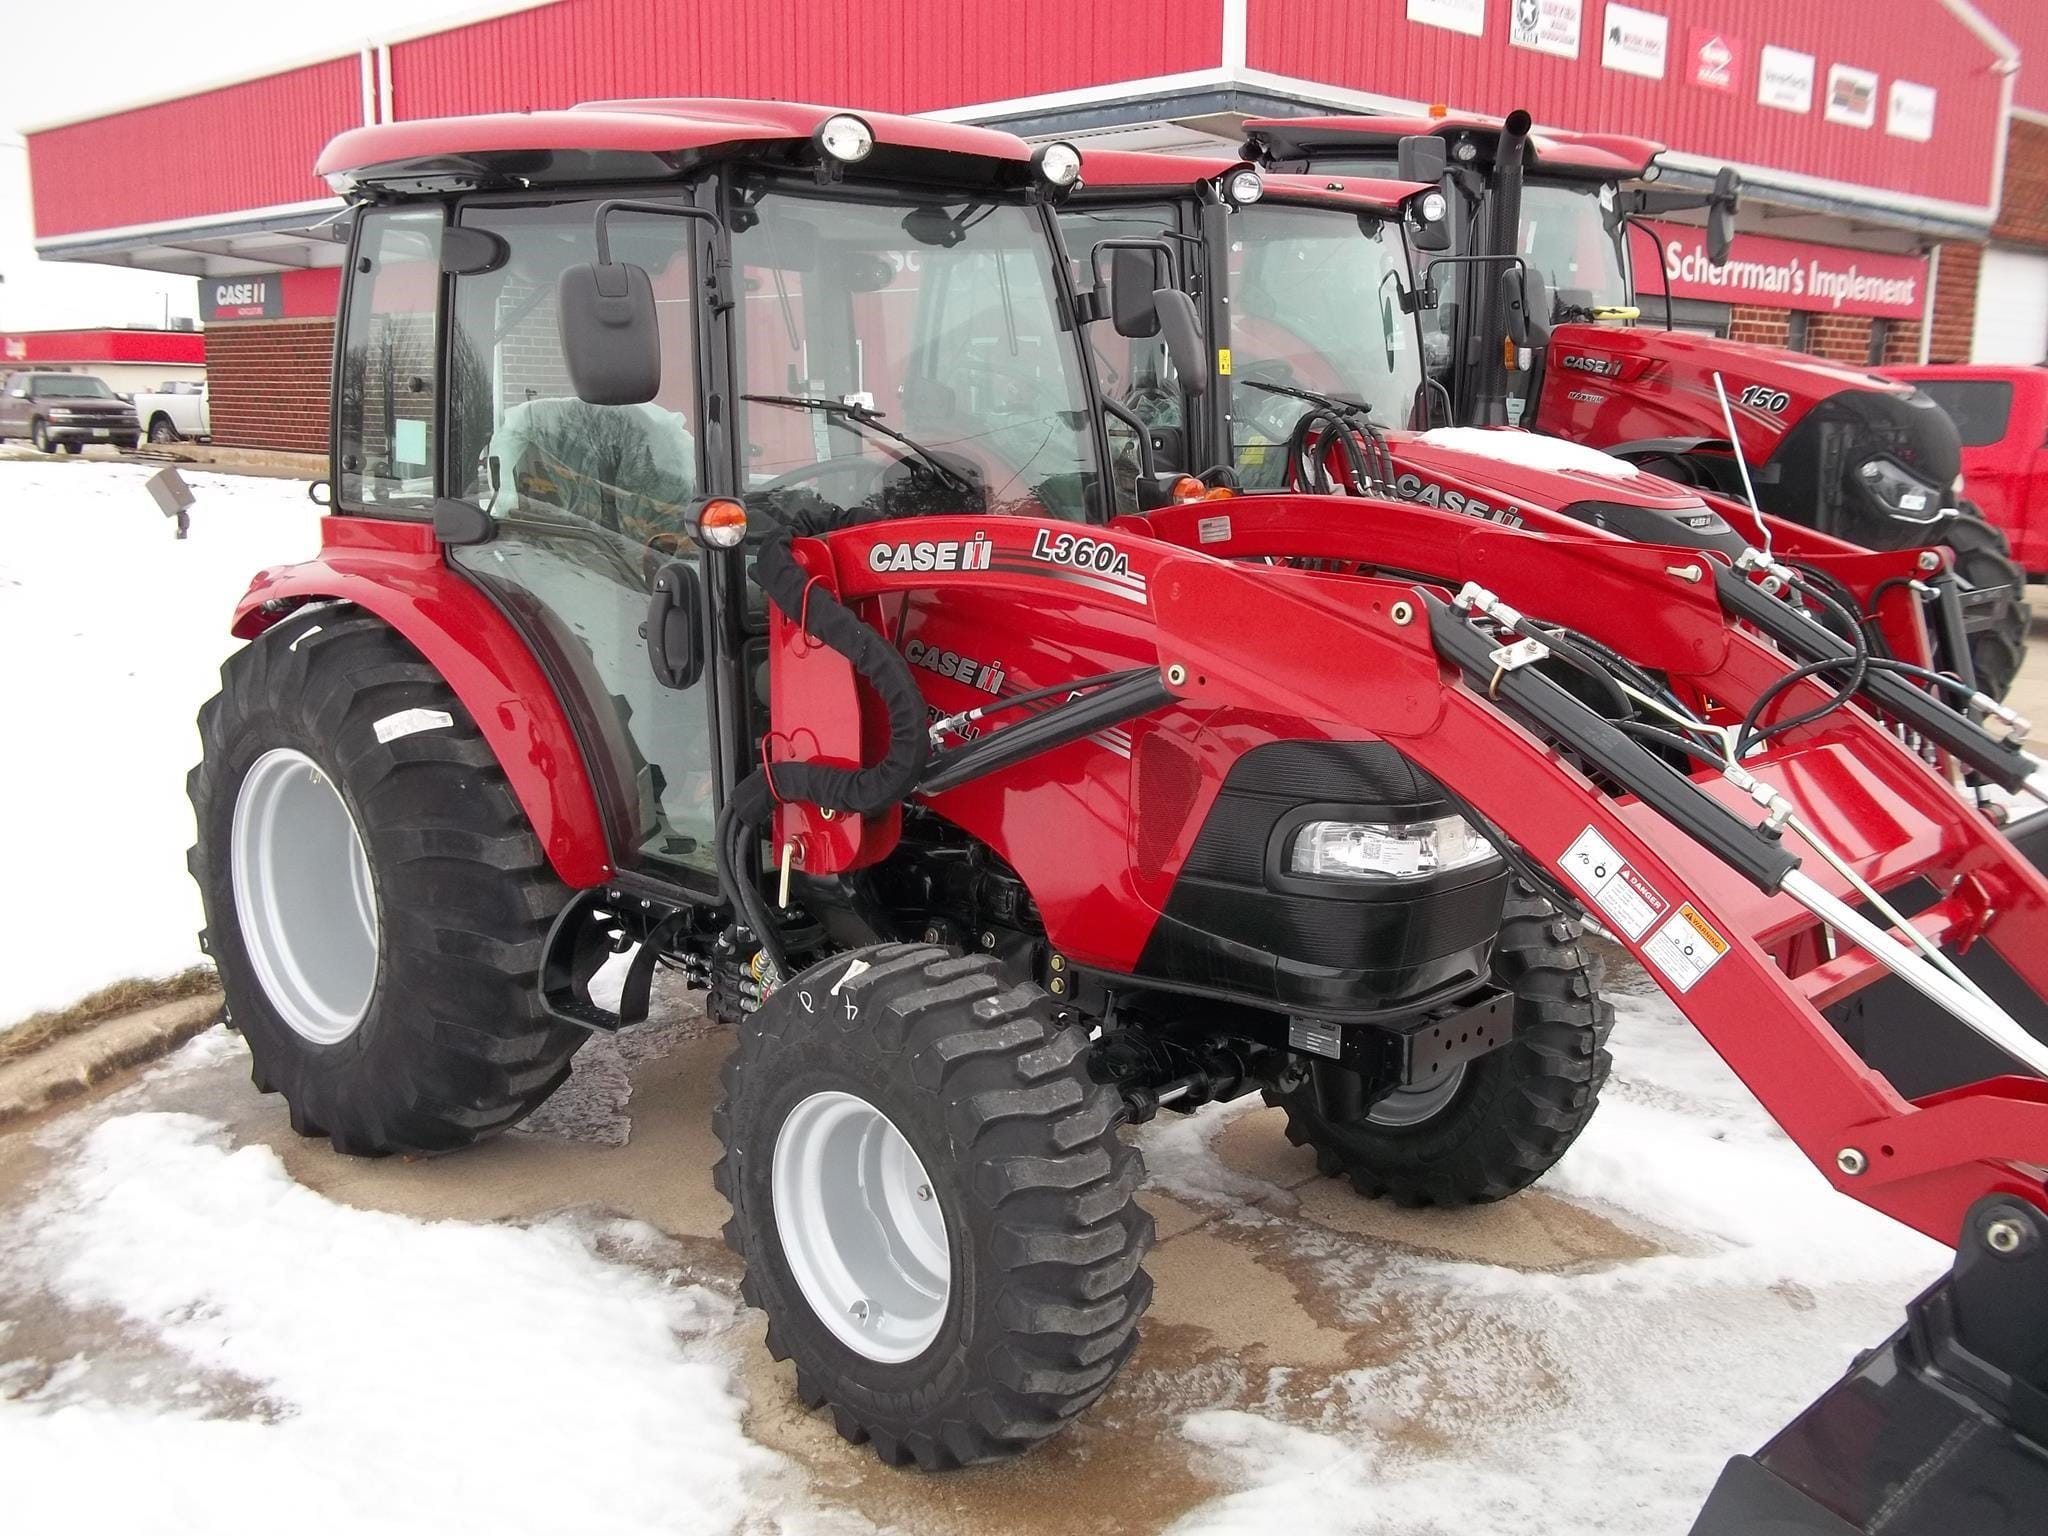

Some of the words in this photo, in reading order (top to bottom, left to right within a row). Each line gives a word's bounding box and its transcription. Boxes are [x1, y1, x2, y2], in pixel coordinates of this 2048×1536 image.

[1665, 240, 1804, 295] Scherrman's
[1807, 259, 1916, 308] Implement
[216, 283, 252, 305] CASE
[1563, 355, 1606, 374] CASE
[1739, 384, 1791, 415] 150
[1396, 473, 1490, 519] CASE
[869, 542, 958, 571] CASE
[1032, 529, 1129, 577] L360A
[904, 639, 978, 684] CASE
[1629, 876, 1662, 910] DANGER
[1692, 918, 1721, 949] WARNING
